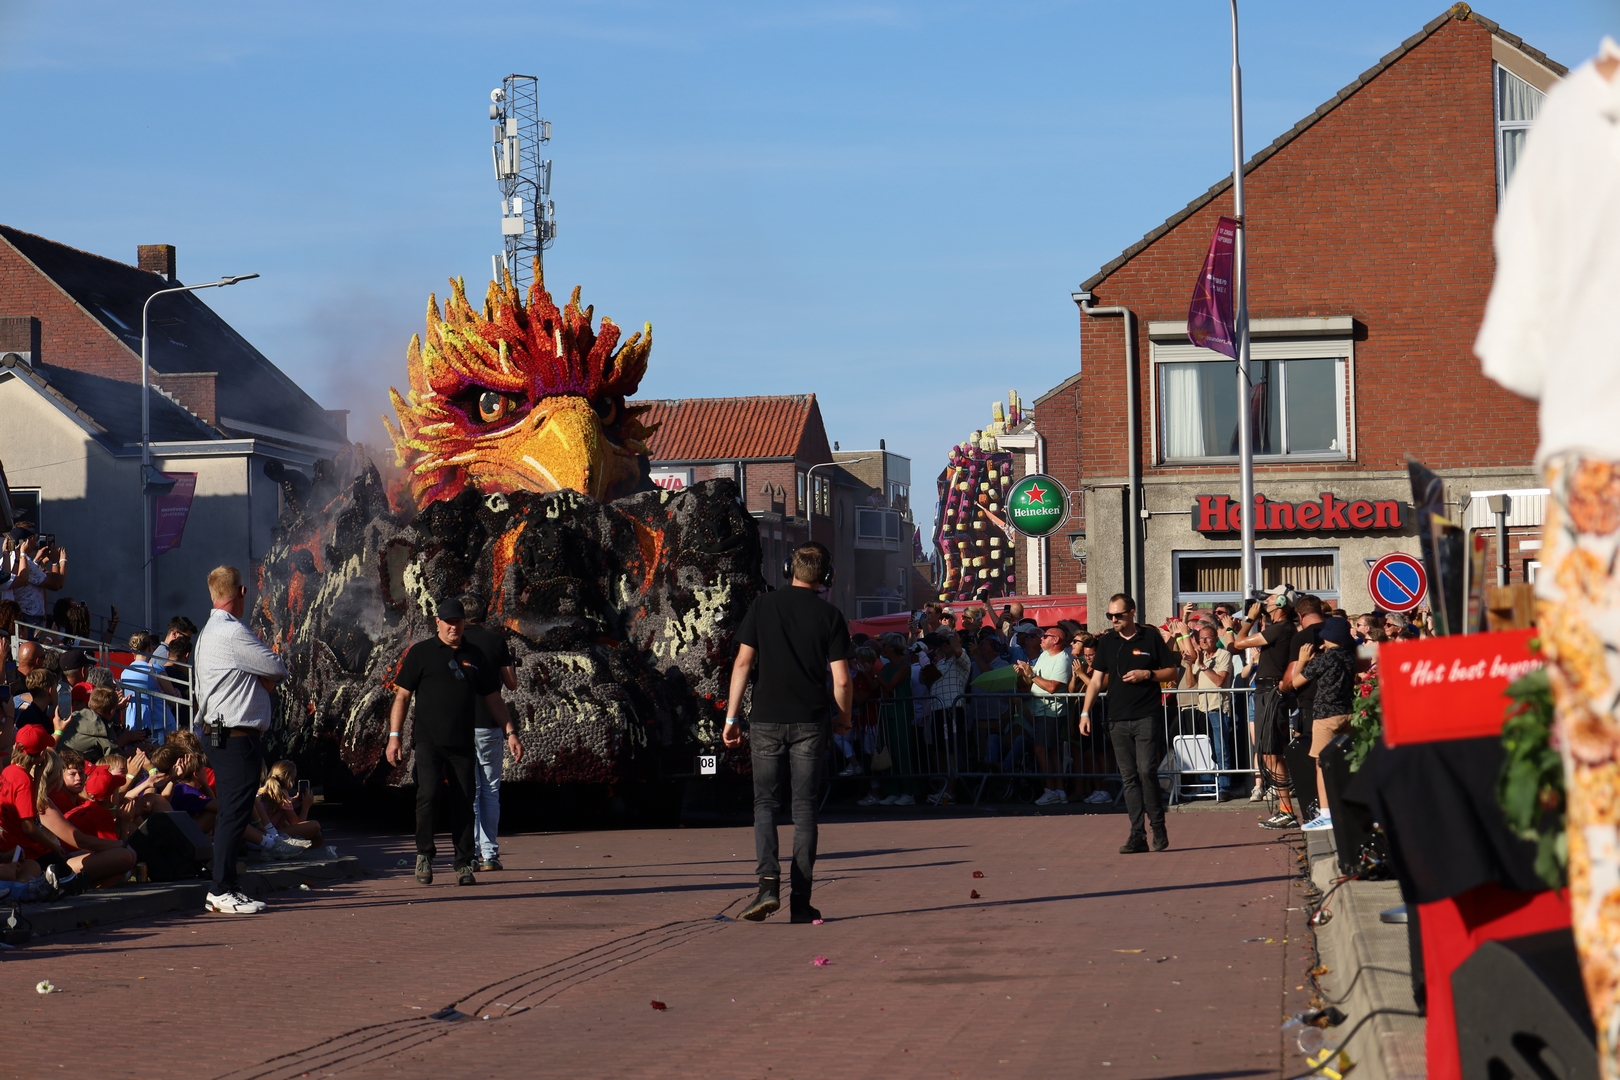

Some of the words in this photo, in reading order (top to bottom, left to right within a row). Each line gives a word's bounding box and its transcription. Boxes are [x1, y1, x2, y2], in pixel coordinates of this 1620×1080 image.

[1014, 506, 1060, 517] Heineken
[1448, 658, 1488, 683] best
[701, 758, 714, 768] 08
